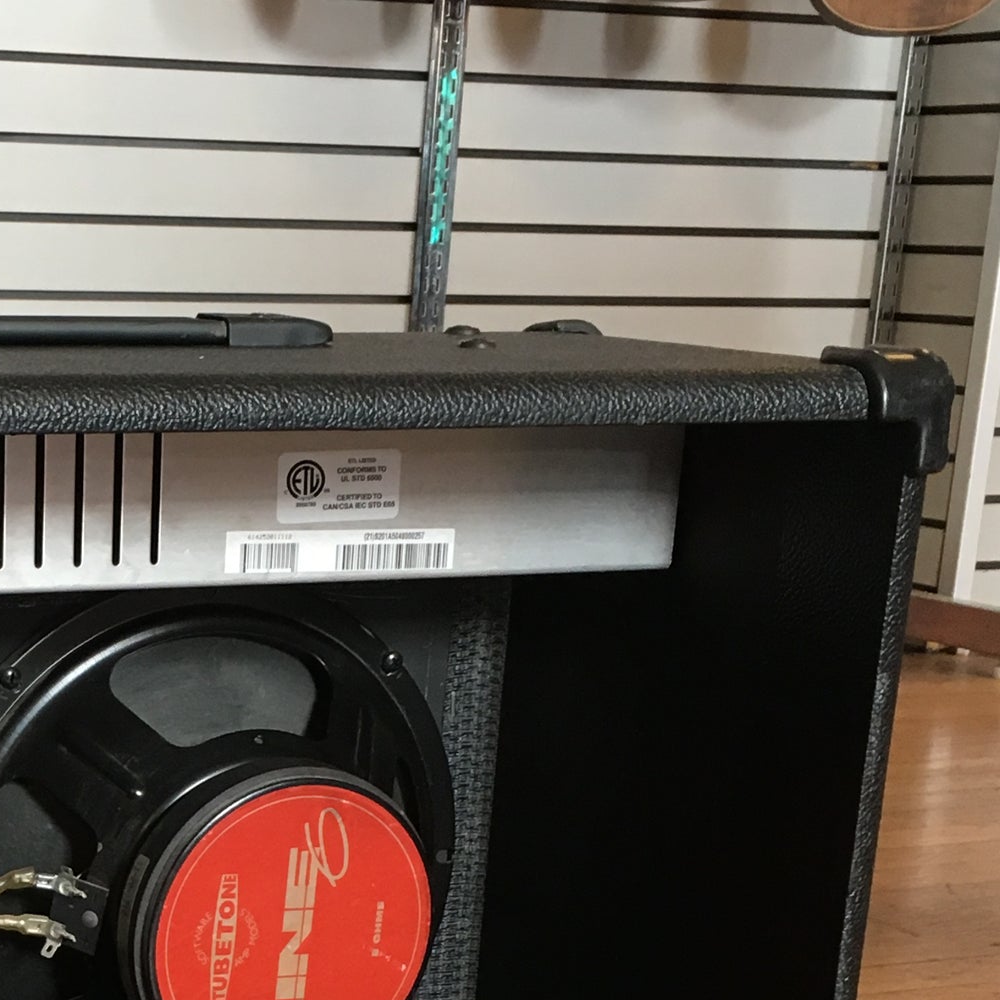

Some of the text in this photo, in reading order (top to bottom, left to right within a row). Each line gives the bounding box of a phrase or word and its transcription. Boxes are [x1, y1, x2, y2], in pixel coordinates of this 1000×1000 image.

[337, 465, 387, 474] CONFORMS TO
[336, 493, 372, 501] CERTIFIED
[372, 901, 385, 944] OHMS
[211, 874, 238, 1000] TUBETONE
